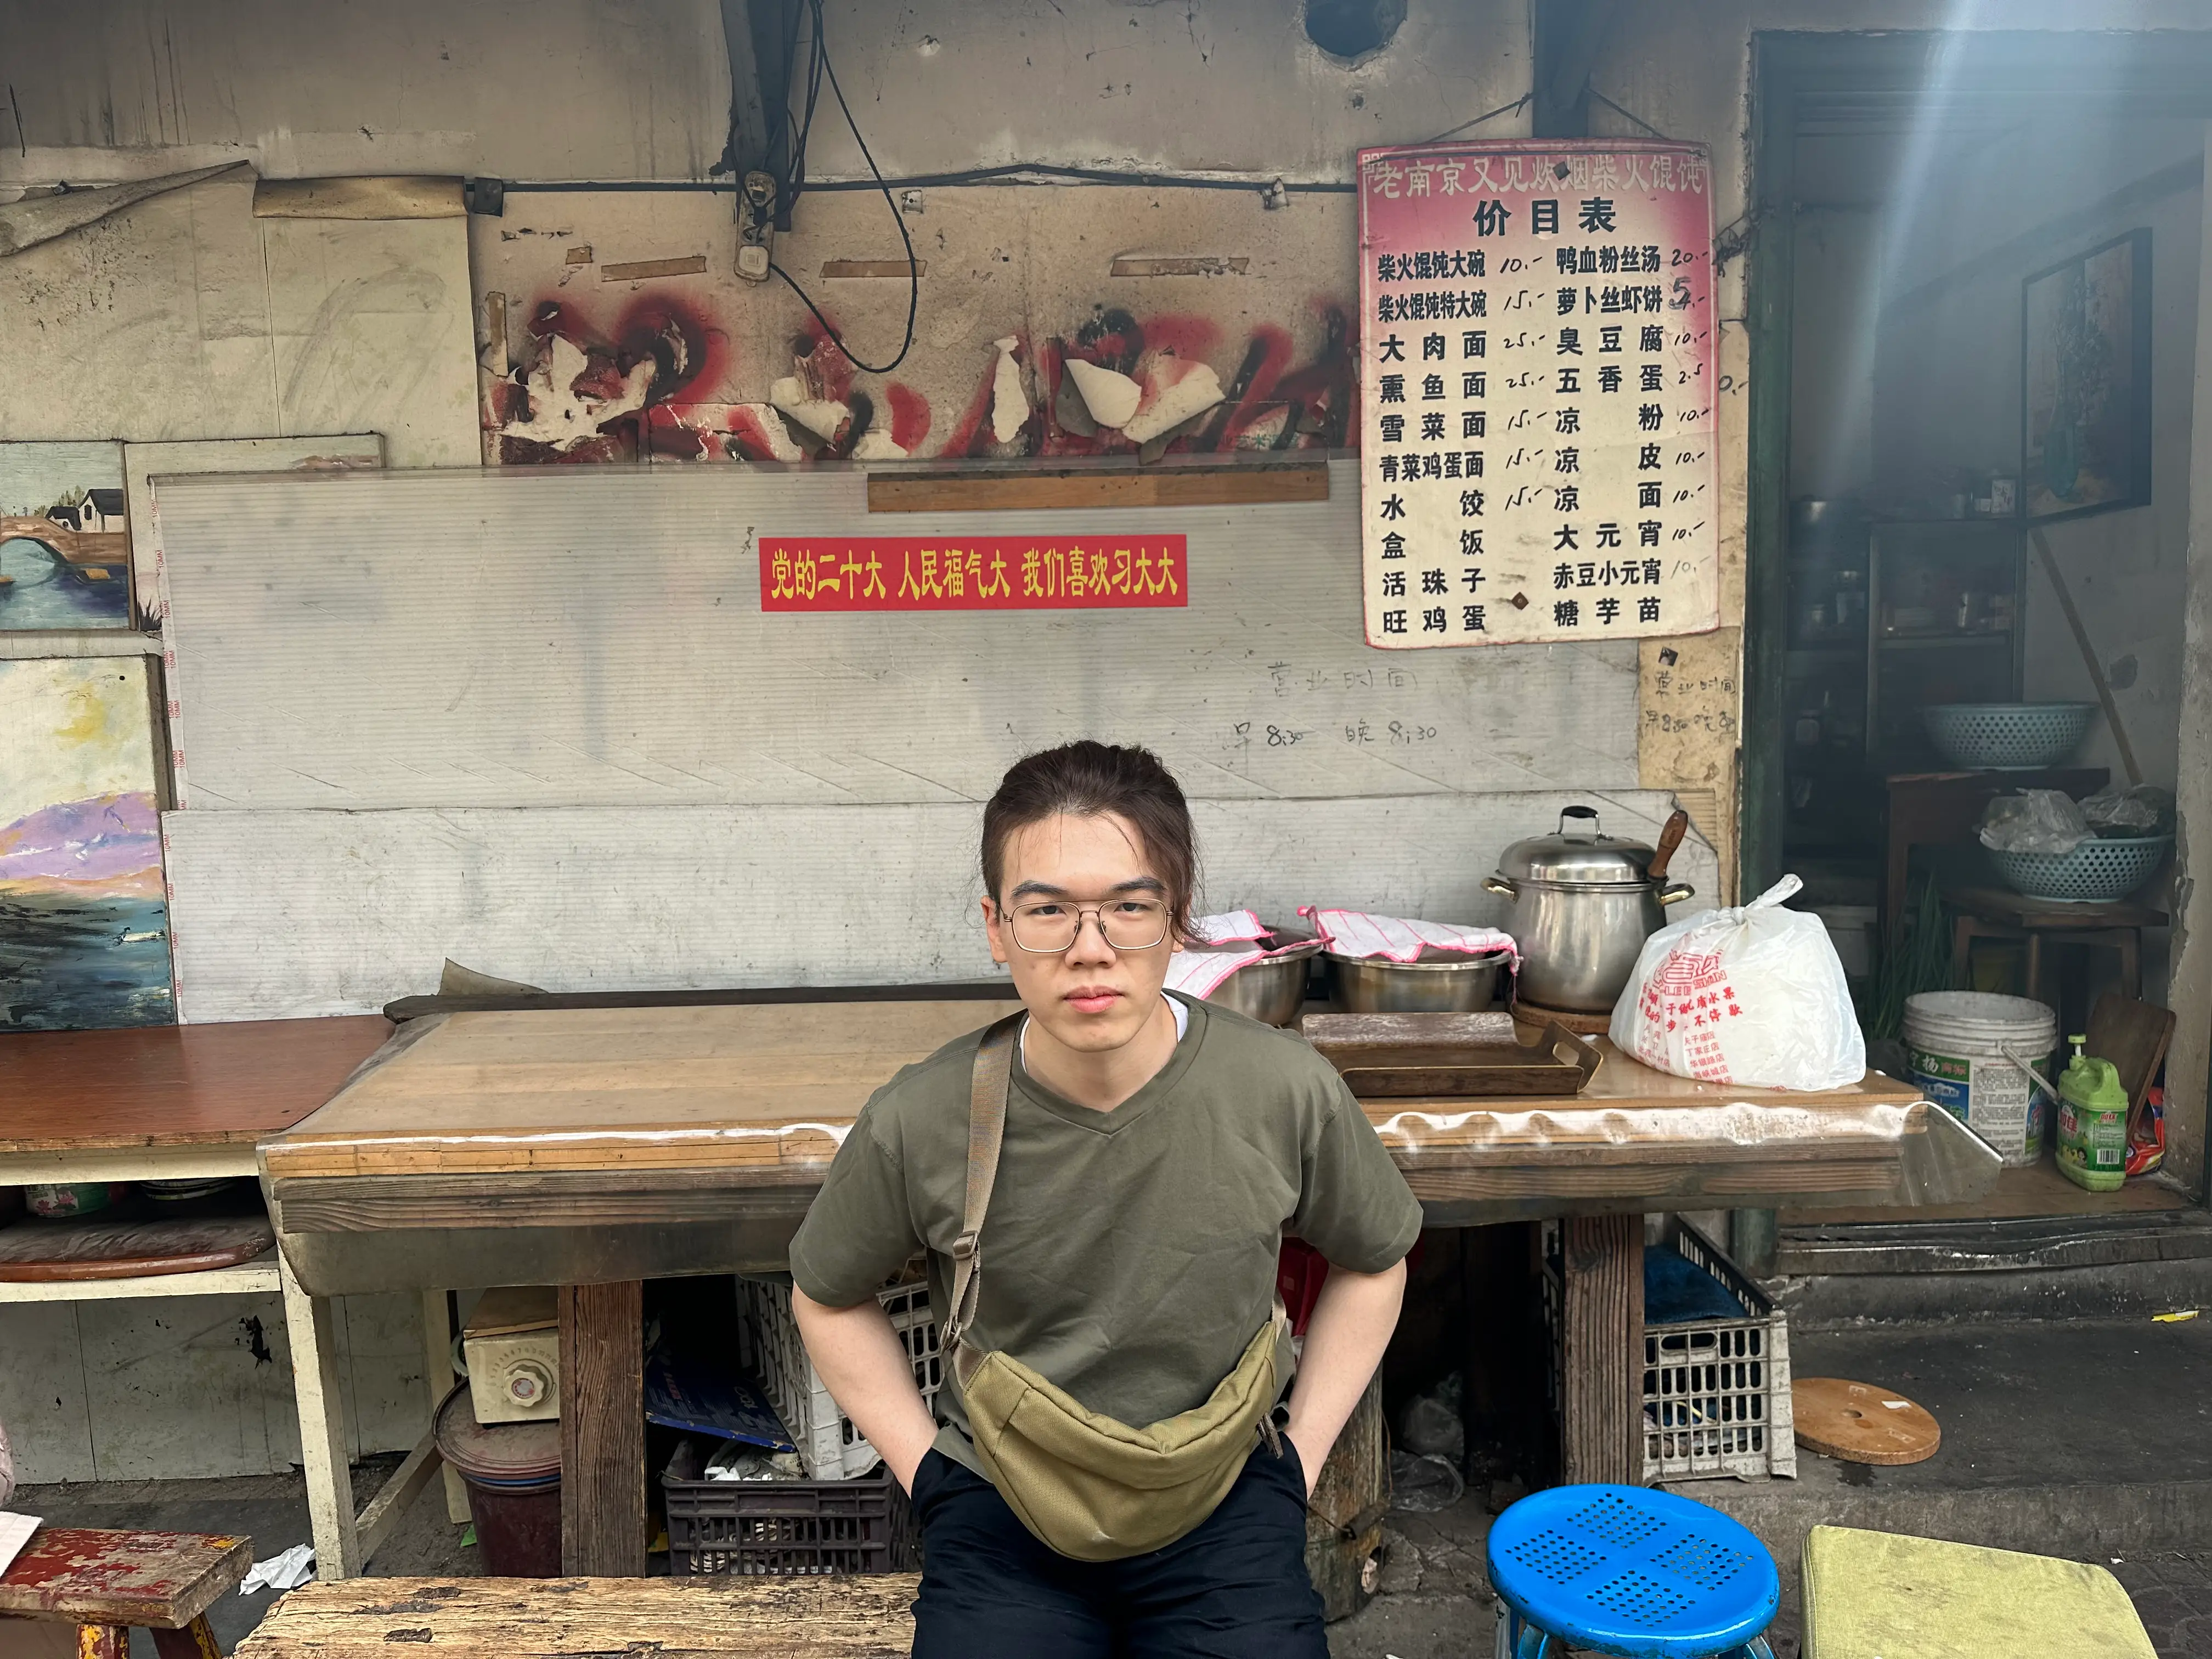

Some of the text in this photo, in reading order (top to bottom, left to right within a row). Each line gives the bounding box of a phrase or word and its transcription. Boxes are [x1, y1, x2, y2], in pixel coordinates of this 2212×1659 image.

[1373, 155, 1702, 198] 老南京又见炊烟柴火馄饨
[1472, 197, 1616, 236] 价目表
[1378, 249, 1485, 282] 柴火馄饨大碗
[1557, 245, 1660, 274] 鸭血粉丝汤
[1379, 290, 1486, 323] 柴火馄饨特大碗
[1557, 285, 1662, 315] 萝卜丝虾饼
[1379, 331, 1486, 363] 大肉面
[1557, 325, 1663, 356] 臭豆腐
[1379, 372, 1486, 403] 熏鱼面
[1556, 365, 1662, 393] 五香蛋
[1380, 411, 1486, 442] 雪菜面
[1379, 452, 1483, 482] 青菜鸡蛋面
[1554, 520, 1662, 551] 大元宵
[771, 545, 1178, 601] 党的二十大 人民福气大 我们喜欢习大大
[1383, 568, 1486, 596] 活珠子
[1554, 558, 1661, 589] 赤豆小元宵
[1384, 605, 1486, 634] 旺鸡蛋
[1554, 596, 1661, 627] 糖芋苗
